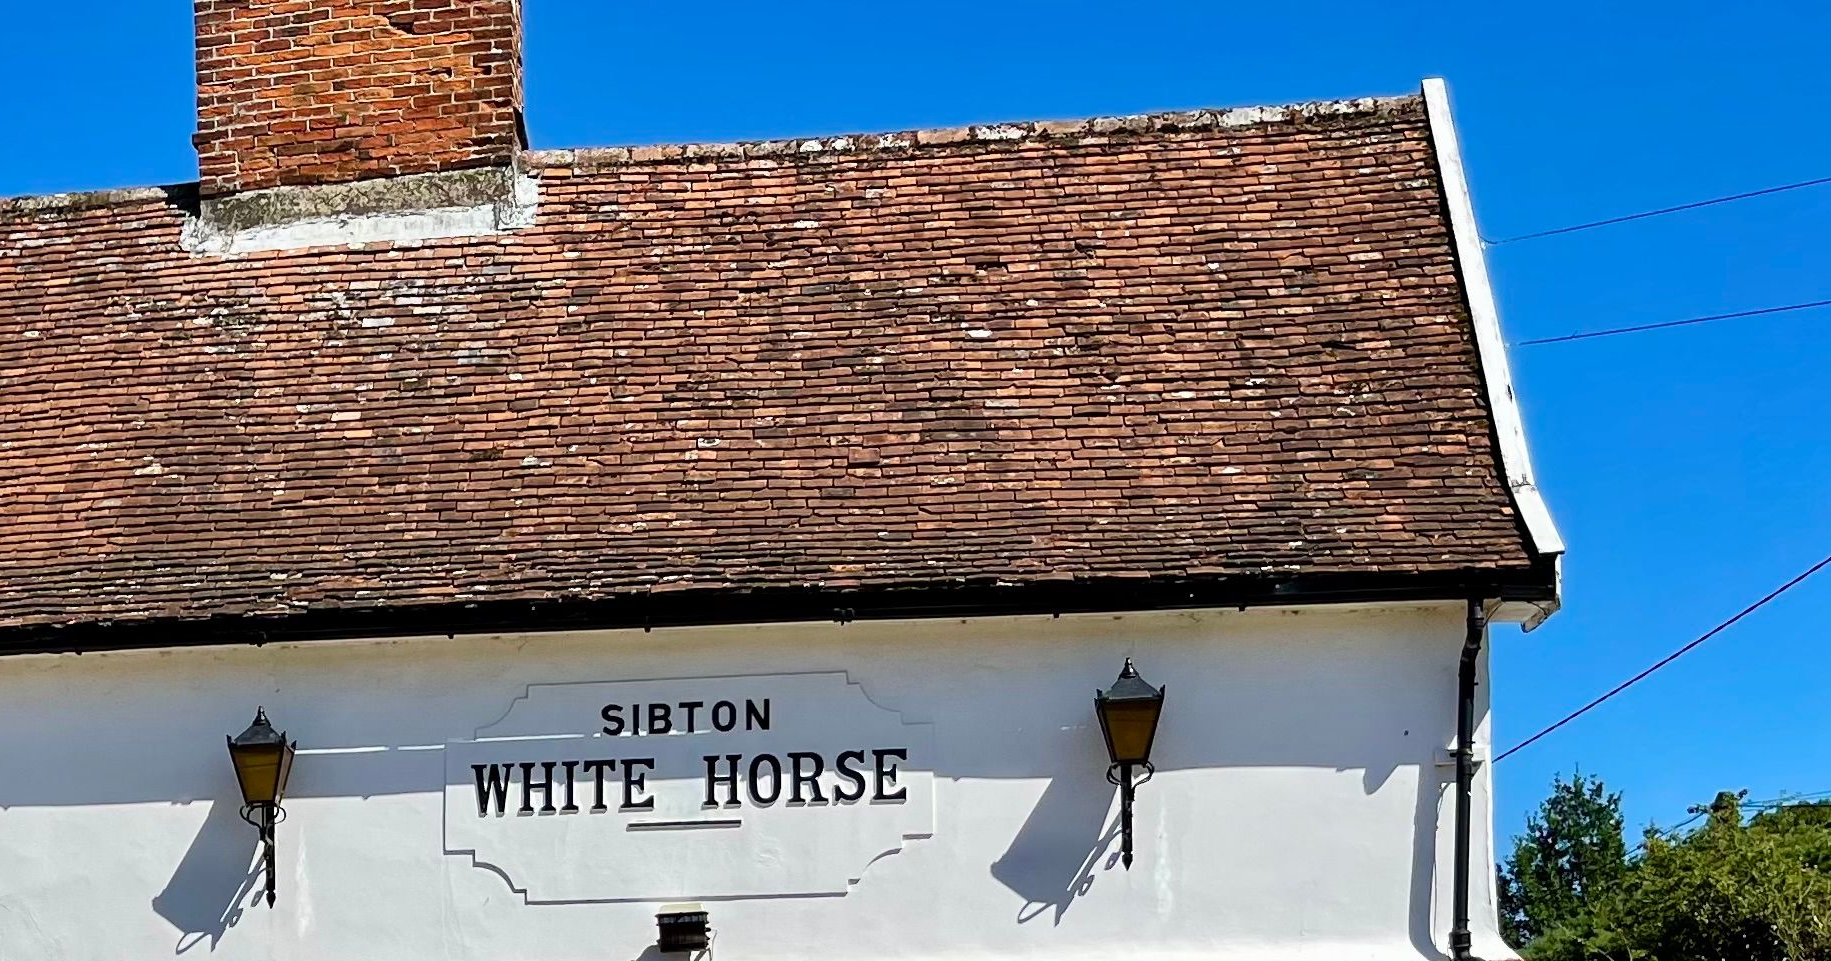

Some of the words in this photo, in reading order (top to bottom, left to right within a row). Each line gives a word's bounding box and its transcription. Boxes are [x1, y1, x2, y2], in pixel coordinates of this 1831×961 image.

[601, 699, 770, 735] SIBTON
[471, 757, 655, 815] WHITE
[702, 748, 908, 809] HORSE
